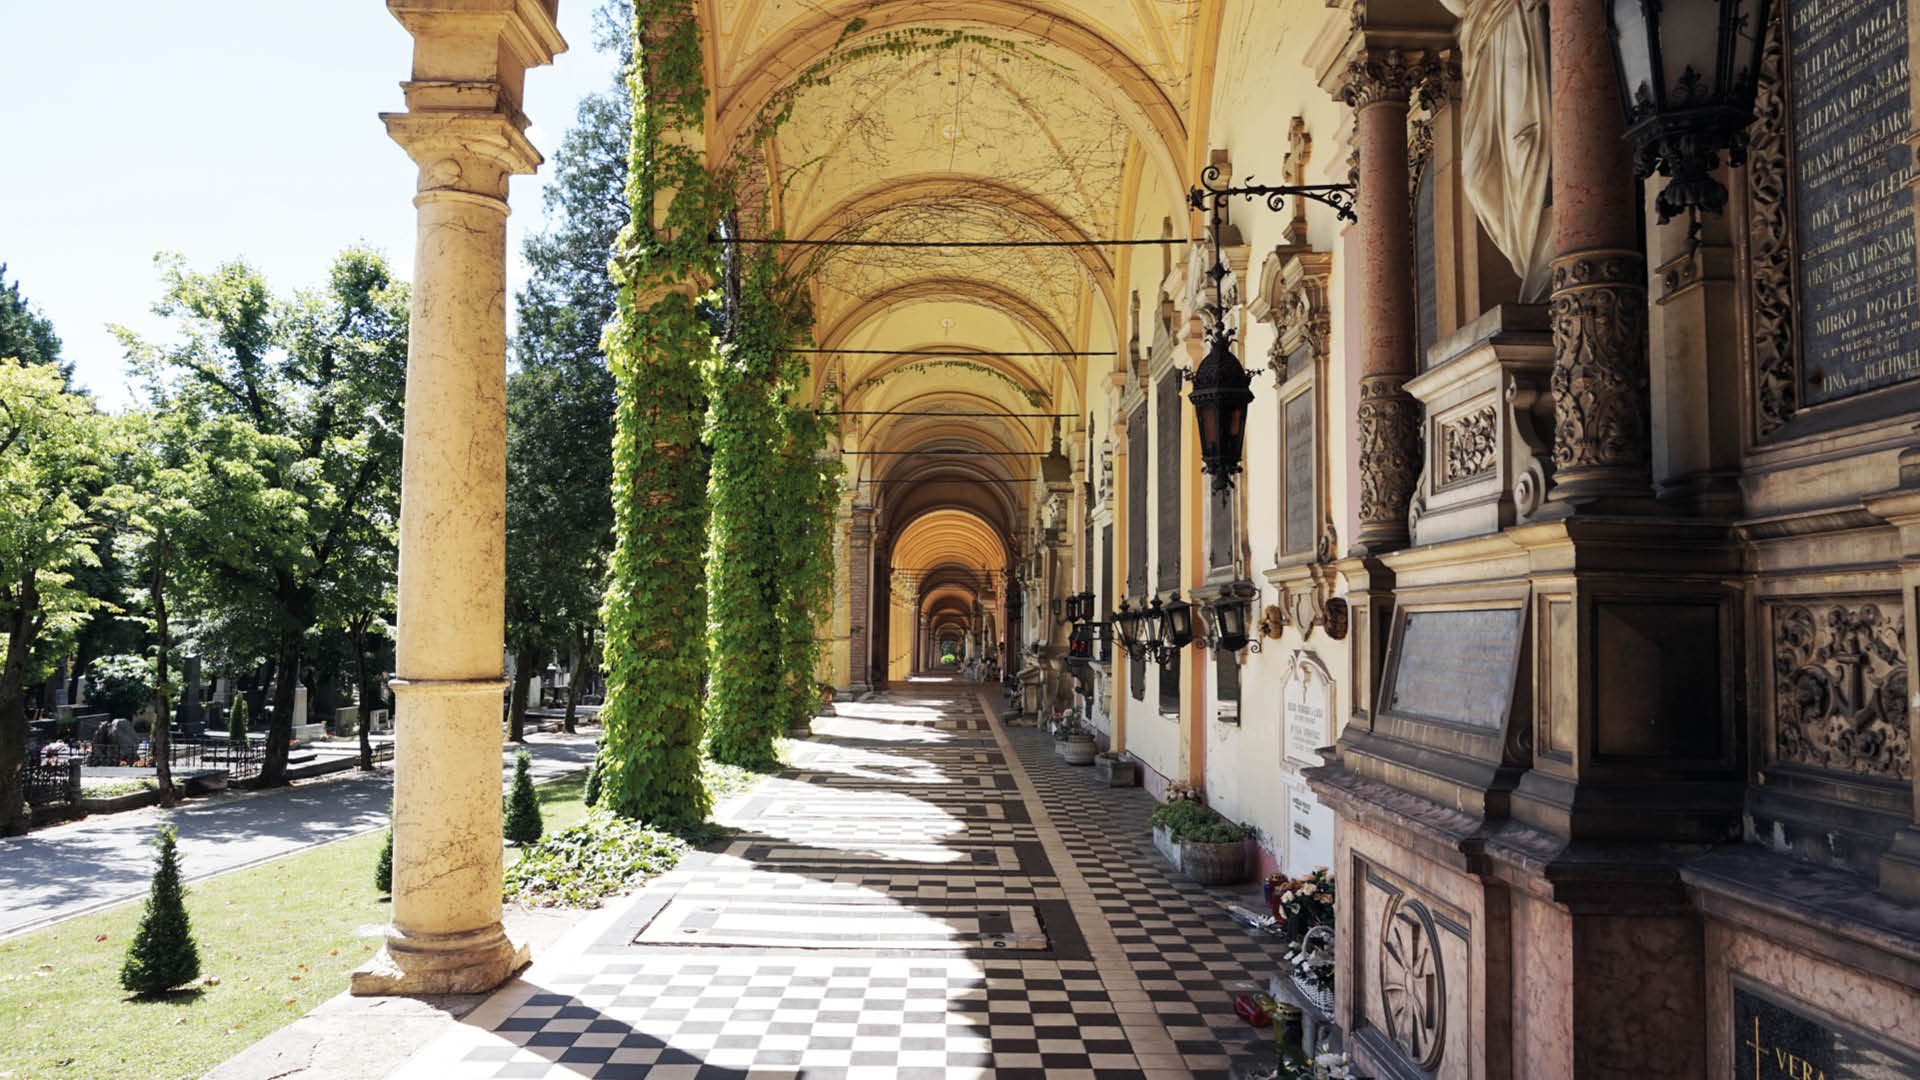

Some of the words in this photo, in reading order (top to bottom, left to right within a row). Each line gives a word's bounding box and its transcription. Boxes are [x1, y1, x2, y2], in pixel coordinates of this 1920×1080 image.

[1801, 141, 1842, 182] FRANJO
[1811, 200, 1839, 231] IVKA
[1816, 306, 1856, 338] MIRKO
